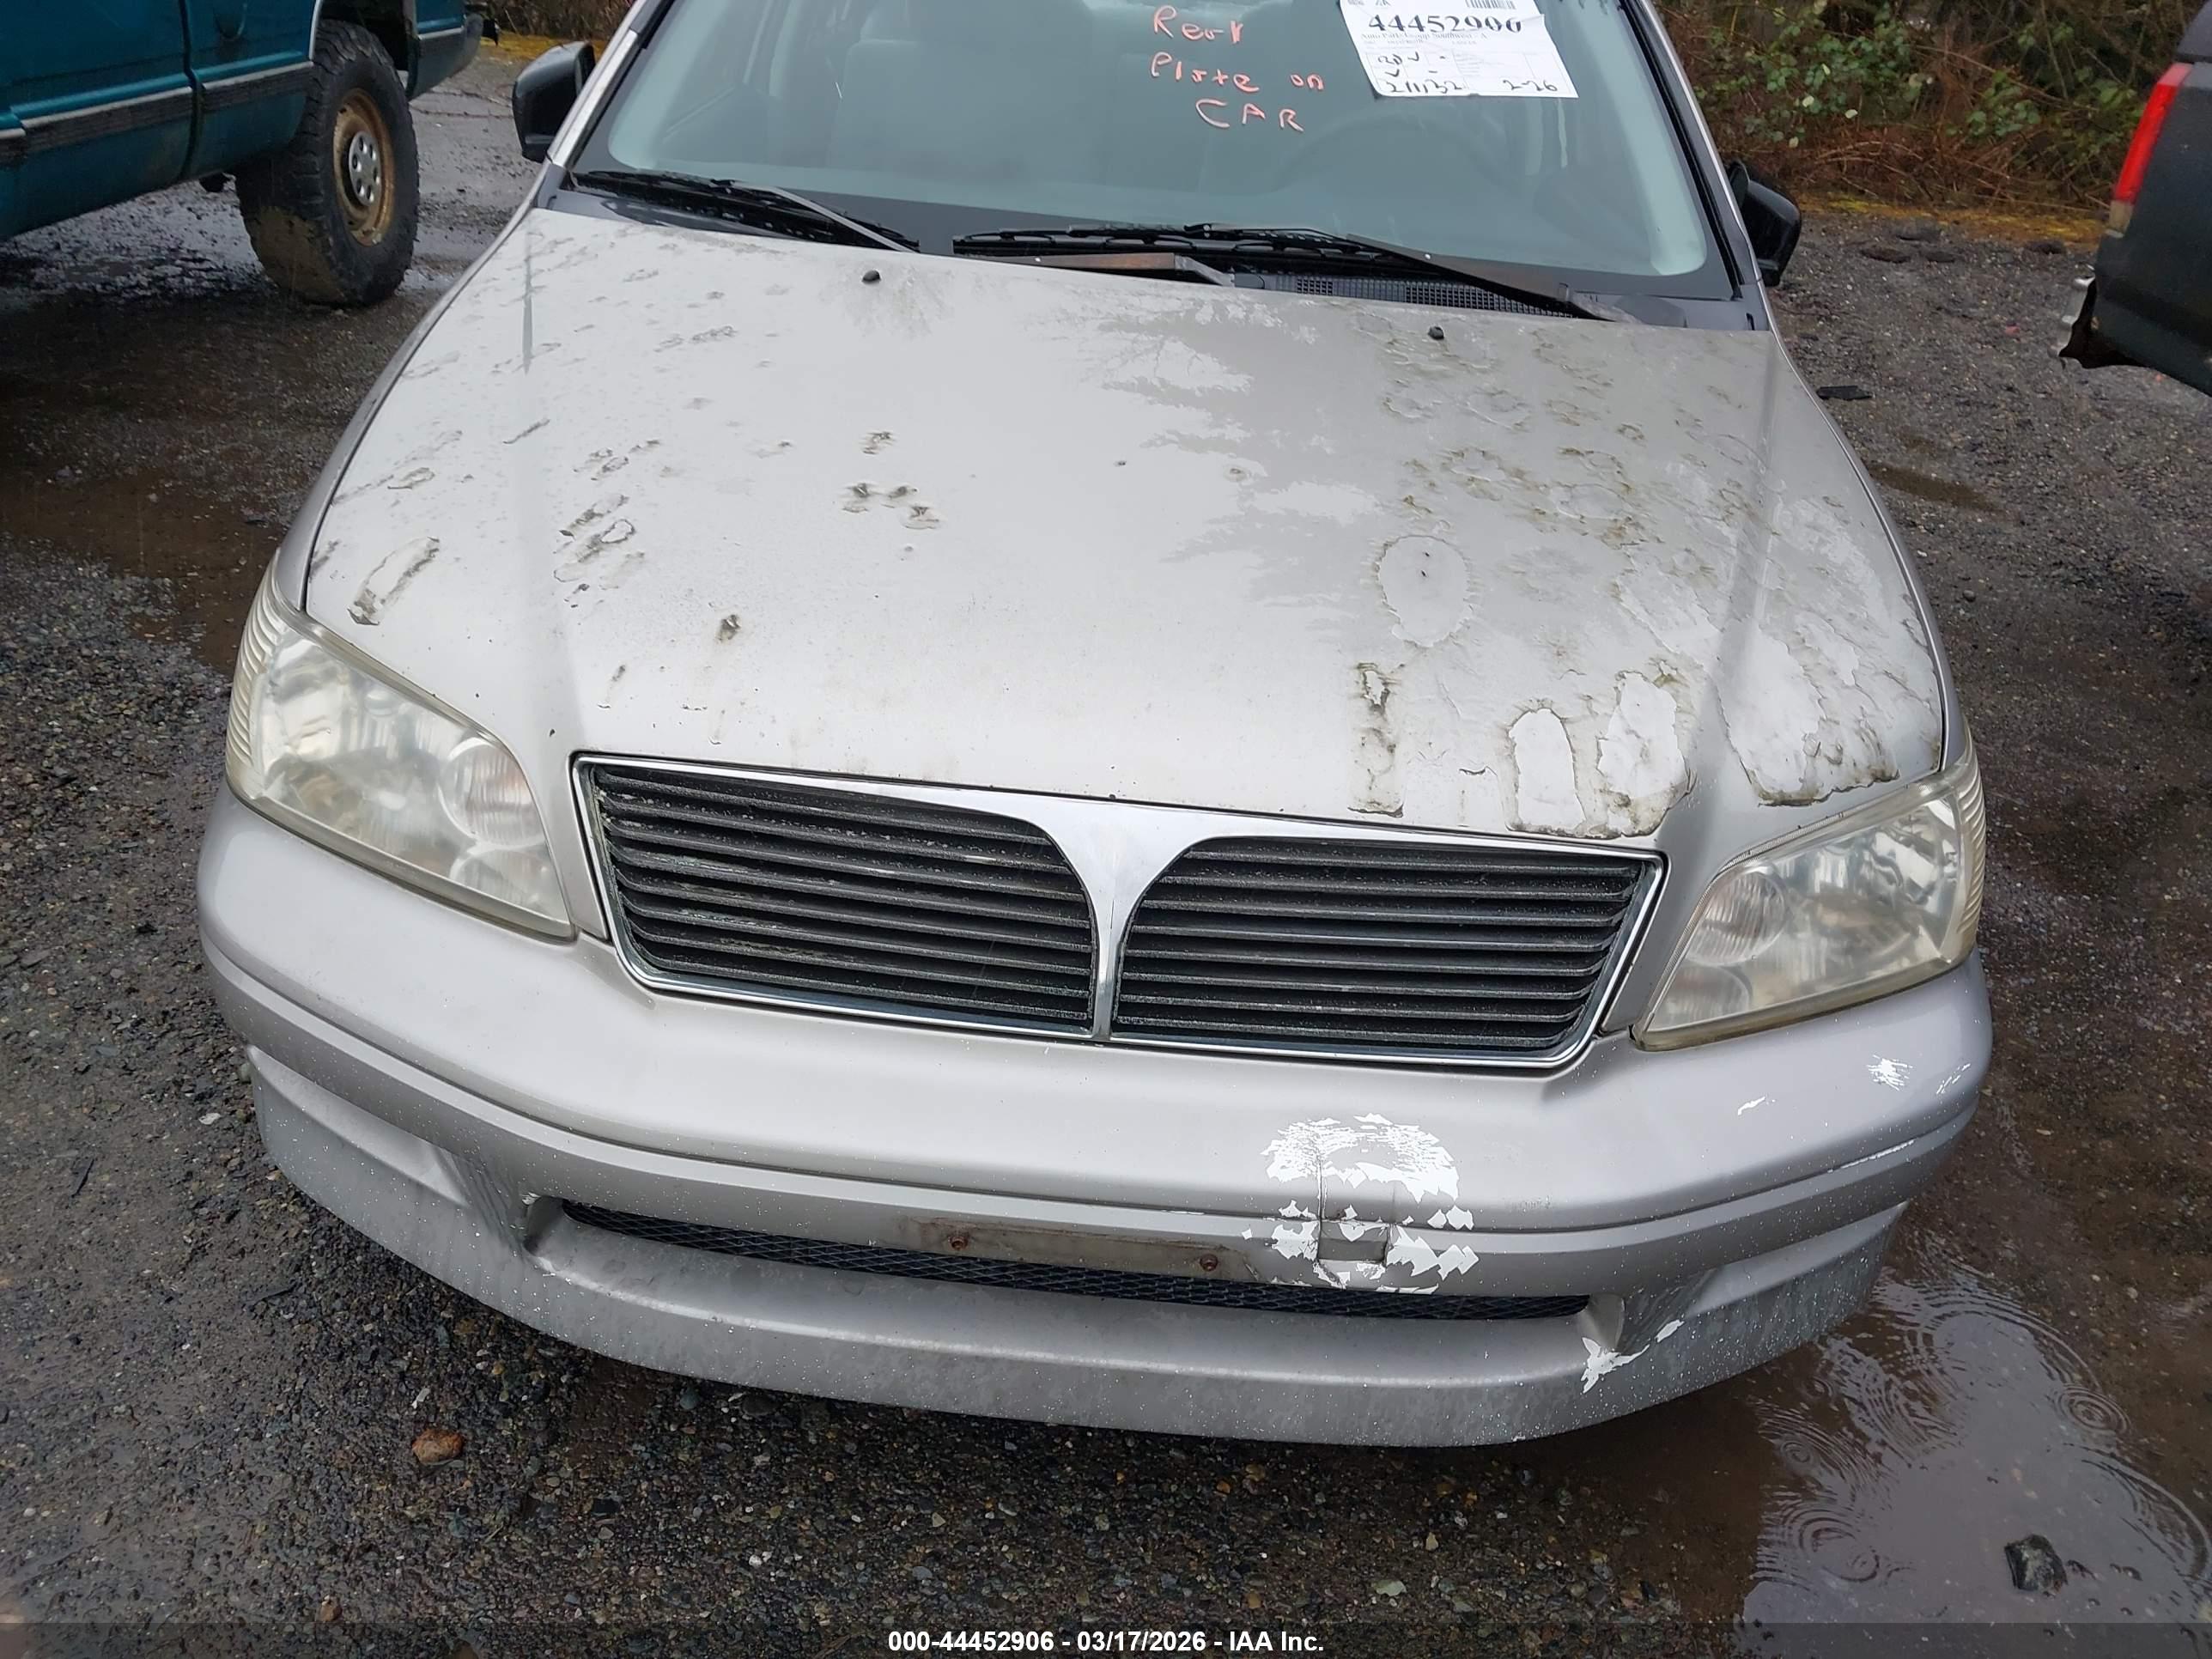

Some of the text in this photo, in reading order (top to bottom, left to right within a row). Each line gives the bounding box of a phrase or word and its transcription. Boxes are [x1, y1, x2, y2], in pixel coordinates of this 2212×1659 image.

[1151, 52, 1324, 93] Plate on
[1195, 98, 1304, 132] CAR
